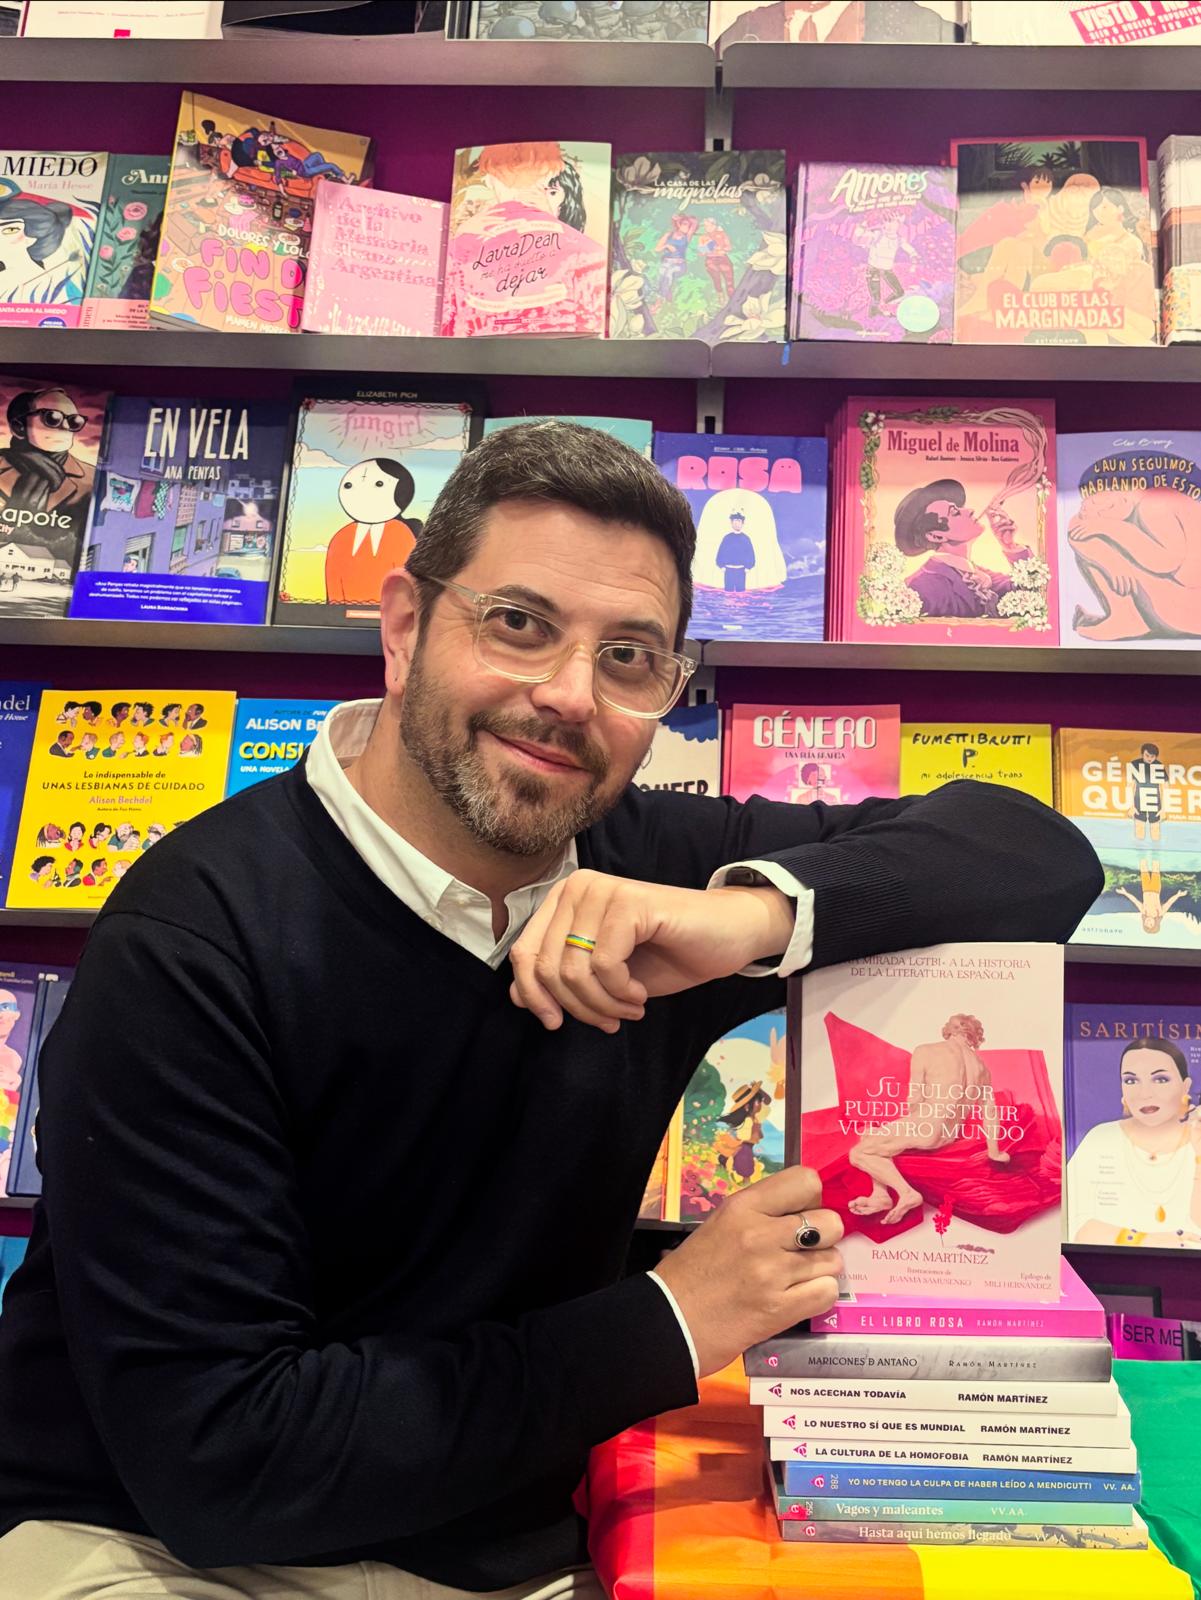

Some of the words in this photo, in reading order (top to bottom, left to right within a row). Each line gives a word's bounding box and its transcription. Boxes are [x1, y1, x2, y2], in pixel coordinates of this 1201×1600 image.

[1076, 1, 1138, 32] VISTO
[1138, 1, 1155, 17] Y
[2, 156, 98, 177] MIEDO
[653, 173, 743, 211] magnolias
[339, 197, 422, 223] Archivo
[338, 213, 360, 228] de
[366, 217, 383, 232] la
[218, 223, 270, 247] DOLORES
[335, 226, 429, 256] Memoria
[472, 243, 519, 270] Laura
[518, 232, 561, 258] Dean
[331, 258, 436, 288] Argentina
[496, 267, 548, 297] dejar
[1003, 293, 1018, 308] EL
[1022, 292, 1056, 308] CLUB
[1061, 292, 1078, 307] DE
[1083, 291, 1109, 307] LAS
[995, 308, 1123, 330] MARGINADAS
[356, 391, 397, 399] ELIZABETH
[400, 391, 418, 399] PICH
[344, 407, 423, 440] fungirl
[144, 407, 181, 458] EN
[188, 408, 249, 460] VELA
[887, 430, 942, 455] Miguel
[946, 437, 960, 452] de
[963, 431, 1019, 452] Molina
[164, 465, 183, 479] ANA
[187, 465, 221, 480] PENYAS
[1131, 456, 1194, 474] SEGUIMOS
[677, 455, 803, 494] ROSA
[1080, 476, 1147, 498] HABLANDO
[1153, 474, 1168, 488] DE
[0, 508, 73, 529] apote
[245, 717, 302, 731] ALISON
[753, 710, 877, 749] GÉNERO
[912, 732, 1031, 746] FUMETTIBRUTTI
[95, 770, 153, 780] indispensable
[155, 771, 166, 779] de
[240, 765, 257, 773] UNA
[936, 771, 993, 780] adolescencia
[998, 770, 1023, 779] trans
[42, 782, 72, 790] UNAS
[75, 782, 134, 790] LESBIANAS
[137, 782, 151, 790] DE
[153, 782, 205, 791] CUIDADO
[88, 796, 116, 804] Alison
[118, 796, 153, 804] Bechdel
[1082, 785, 1201, 814] QUEER
[862, 957, 906, 966] MIRADA
[950, 958, 958, 967] A
[959, 958, 975, 968] LA
[978, 959, 1031, 969] HISTORIA
[851, 968, 866, 977] DE
[868, 968, 883, 977] LA
[885, 968, 954, 979] LITERATURA
[957, 968, 1015, 980] ESPAÑOLA
[866, 1076, 900, 1098] SU
[908, 1082, 994, 1101] FULGOR
[844, 1100, 911, 1118] PUEDE
[918, 1102, 1019, 1121] DESTRUIR
[838, 1119, 934, 1138] VUESTRO
[941, 1123, 1025, 1141] MUNDO
[871, 1249, 919, 1262] RAMÓN
[923, 1251, 989, 1265] MARTÍNEZ
[860, 1315, 874, 1327] EL
[882, 1316, 922, 1328] LIBRO
[930, 1316, 964, 1328] ROSA
[1122, 1324, 1155, 1344] SER
[807, 1357, 865, 1367] MARICONES
[877, 1356, 918, 1367] ANTAÑO
[949, 1360, 982, 1368] RAMÓN
[988, 1360, 1037, 1369] MARTÍNEZ
[790, 1388, 811, 1396] NOS
[813, 1389, 861, 1398] ACECHAN
[863, 1389, 907, 1399] TODAVÍA
[958, 1393, 994, 1402] RAMÓN
[997, 1394, 1048, 1404] MARTÍNEZ
[804, 1420, 817, 1428] LO
[820, 1420, 867, 1429] NUESTRO
[869, 1420, 879, 1430] SÍ
[882, 1422, 902, 1430] QUE
[905, 1423, 917, 1431] ES
[920, 1423, 966, 1432] MUNDIAL
[980, 1424, 1017, 1434] RAMÓN
[1019, 1425, 1071, 1435] MARTÍNEZ
[815, 1448, 828, 1456] LA
[830, 1449, 876, 1458] CULTURA
[879, 1450, 892, 1458] DE
[894, 1451, 907, 1459] LA
[910, 1451, 969, 1461] HOMOFOBIA
[982, 1453, 1019, 1463] RAMÓN
[1021, 1454, 1073, 1465] MARTÍNEZ
[848, 1478, 860, 1486] YO
[862, 1478, 875, 1486] NO
[877, 1479, 908, 1487] TENGO
[910, 1479, 921, 1487] LA
[923, 1479, 951, 1488] CULPA
[954, 1480, 966, 1488] DE
[968, 1480, 998, 1488] HABER
[1000, 1479, 1025, 1489] LEÍDO
[1028, 1481, 1035, 1489] A
[1036, 1482, 1092, 1490] MENDICUTTI
[1103, 1483, 1117, 1491] VV.
[1120, 1483, 1136, 1491] AA.
[836, 1503, 875, 1516] Vagos
[873, 1506, 880, 1517] y
[882, 1503, 944, 1516] maleantes
[859, 1526, 893, 1539] Hasta
[926, 1528, 965, 1540] hemos
[968, 1528, 1012, 1545] llegado
